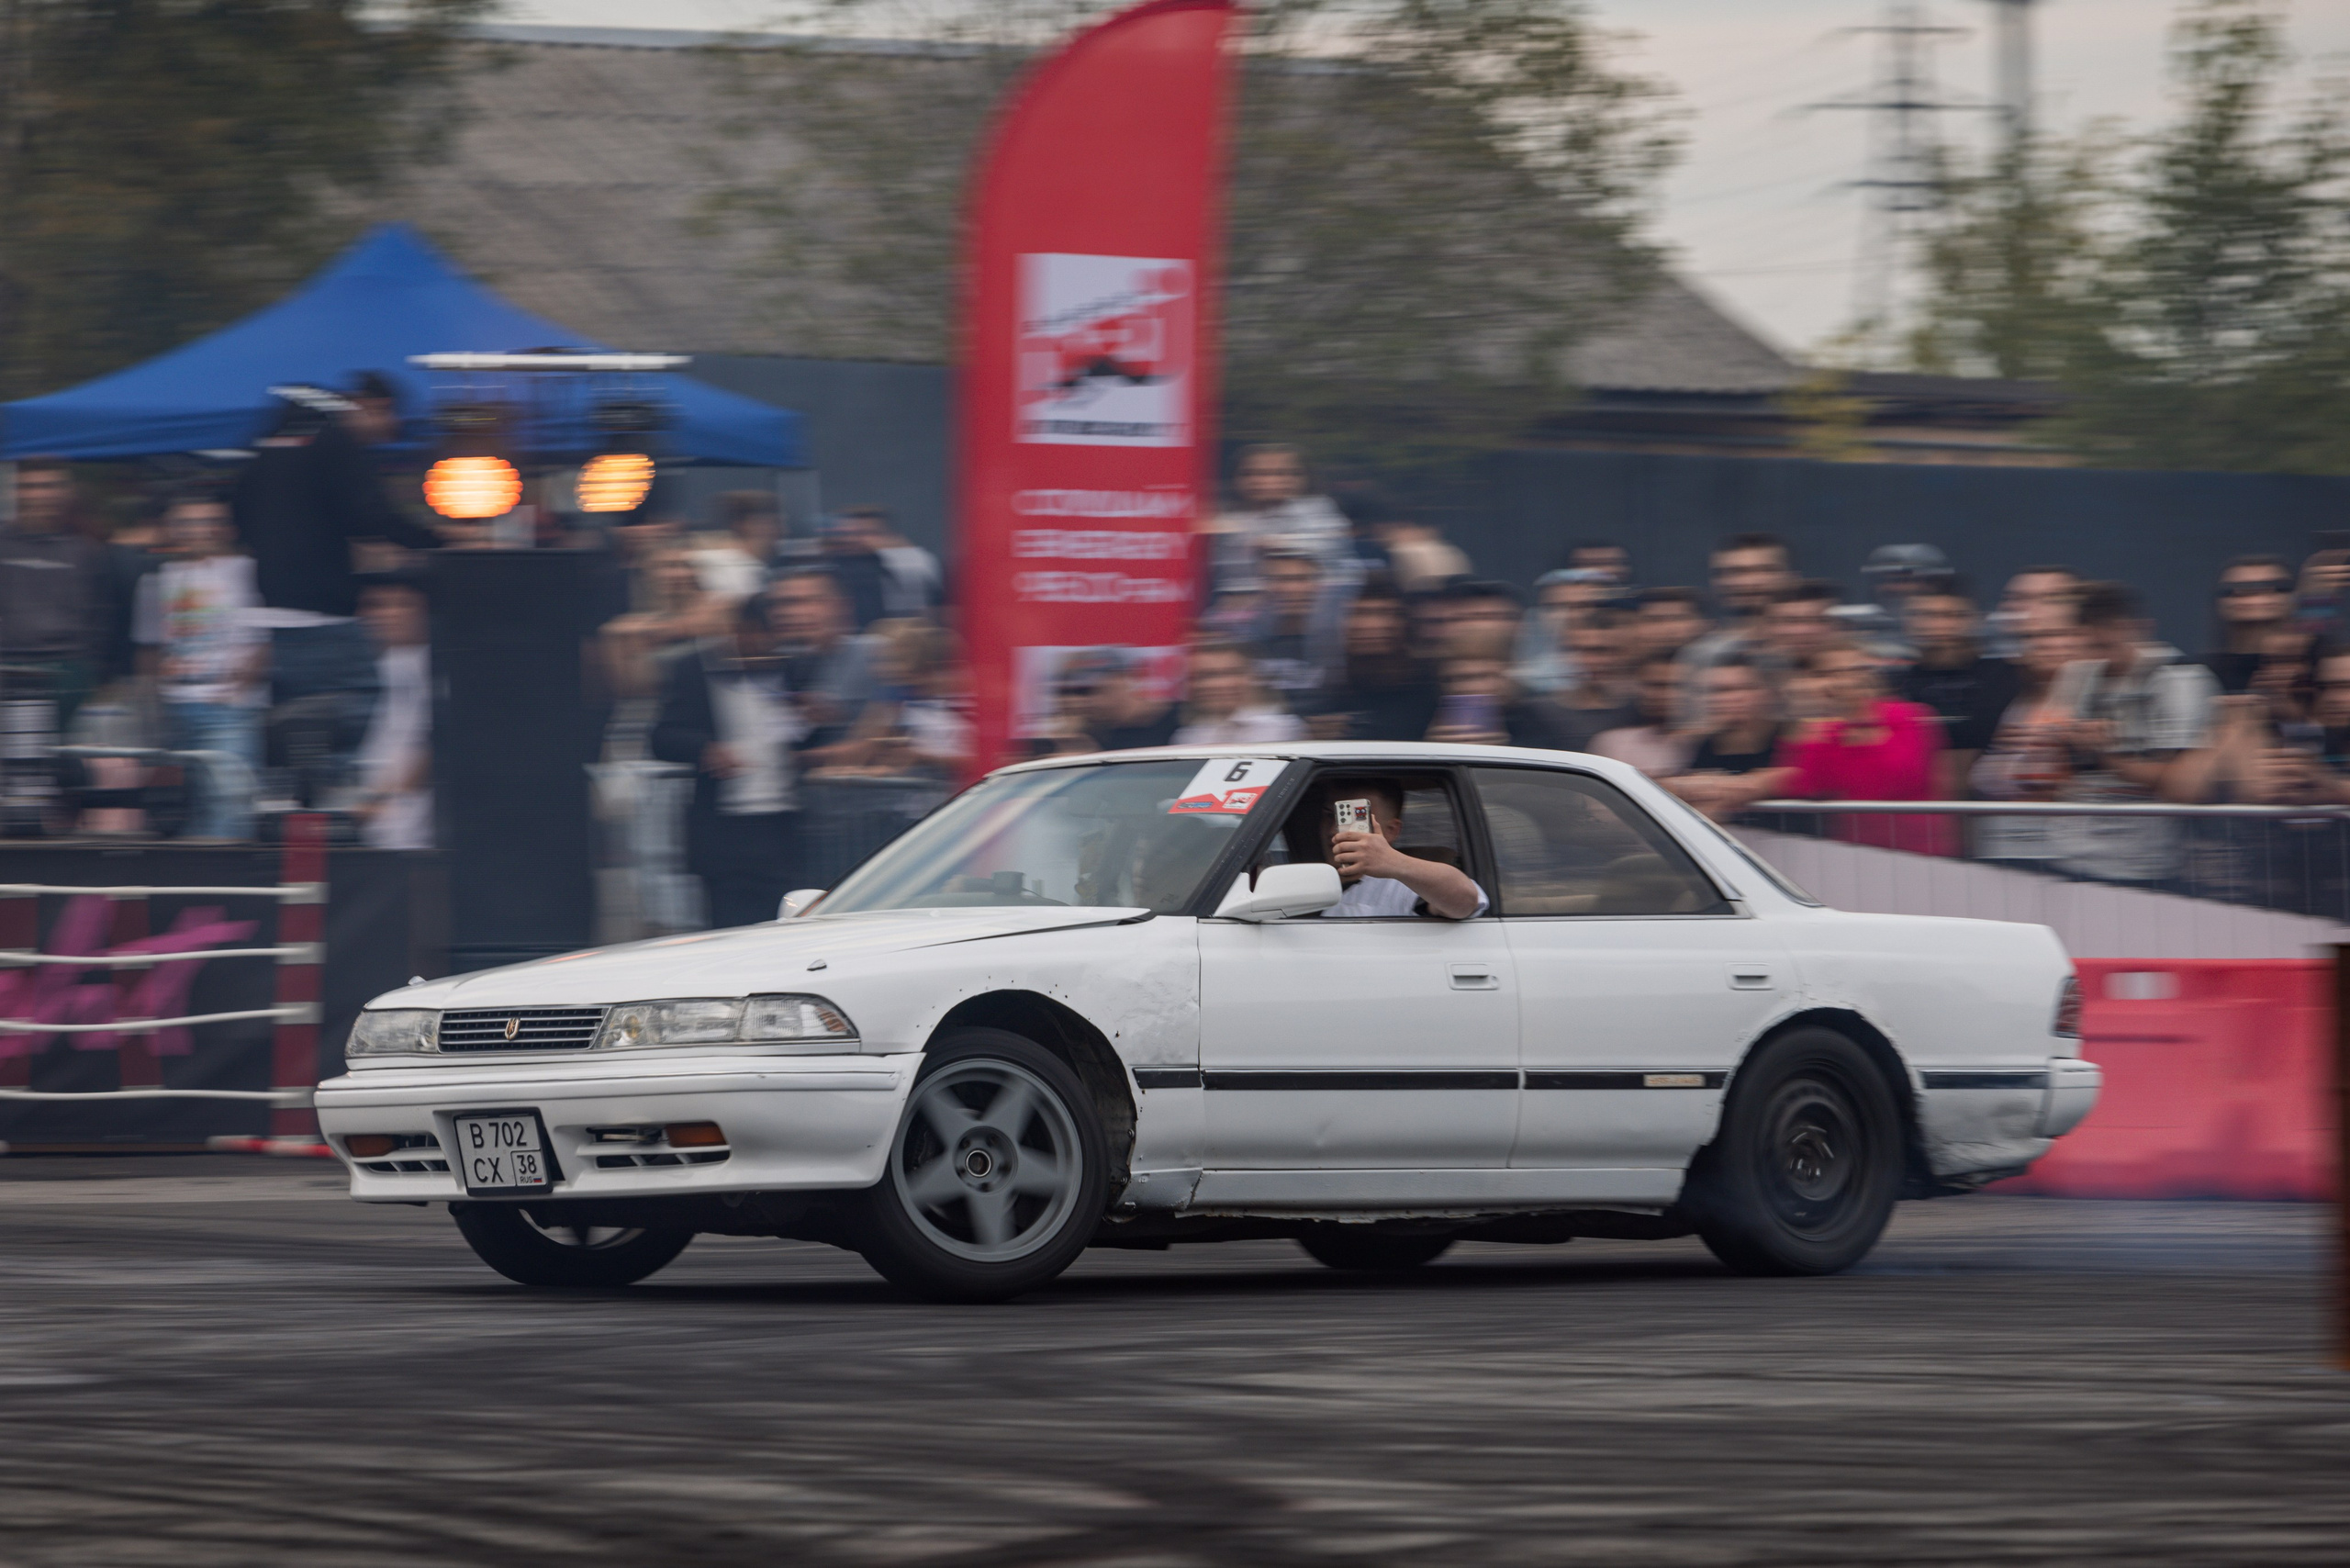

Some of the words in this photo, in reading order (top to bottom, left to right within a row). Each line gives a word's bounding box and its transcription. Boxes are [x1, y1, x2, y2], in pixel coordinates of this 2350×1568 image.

[1224, 761, 1254, 782] 6
[488, 1121, 527, 1148] 702
[516, 1154, 537, 1174] 38
[520, 1176, 533, 1184] RUS
